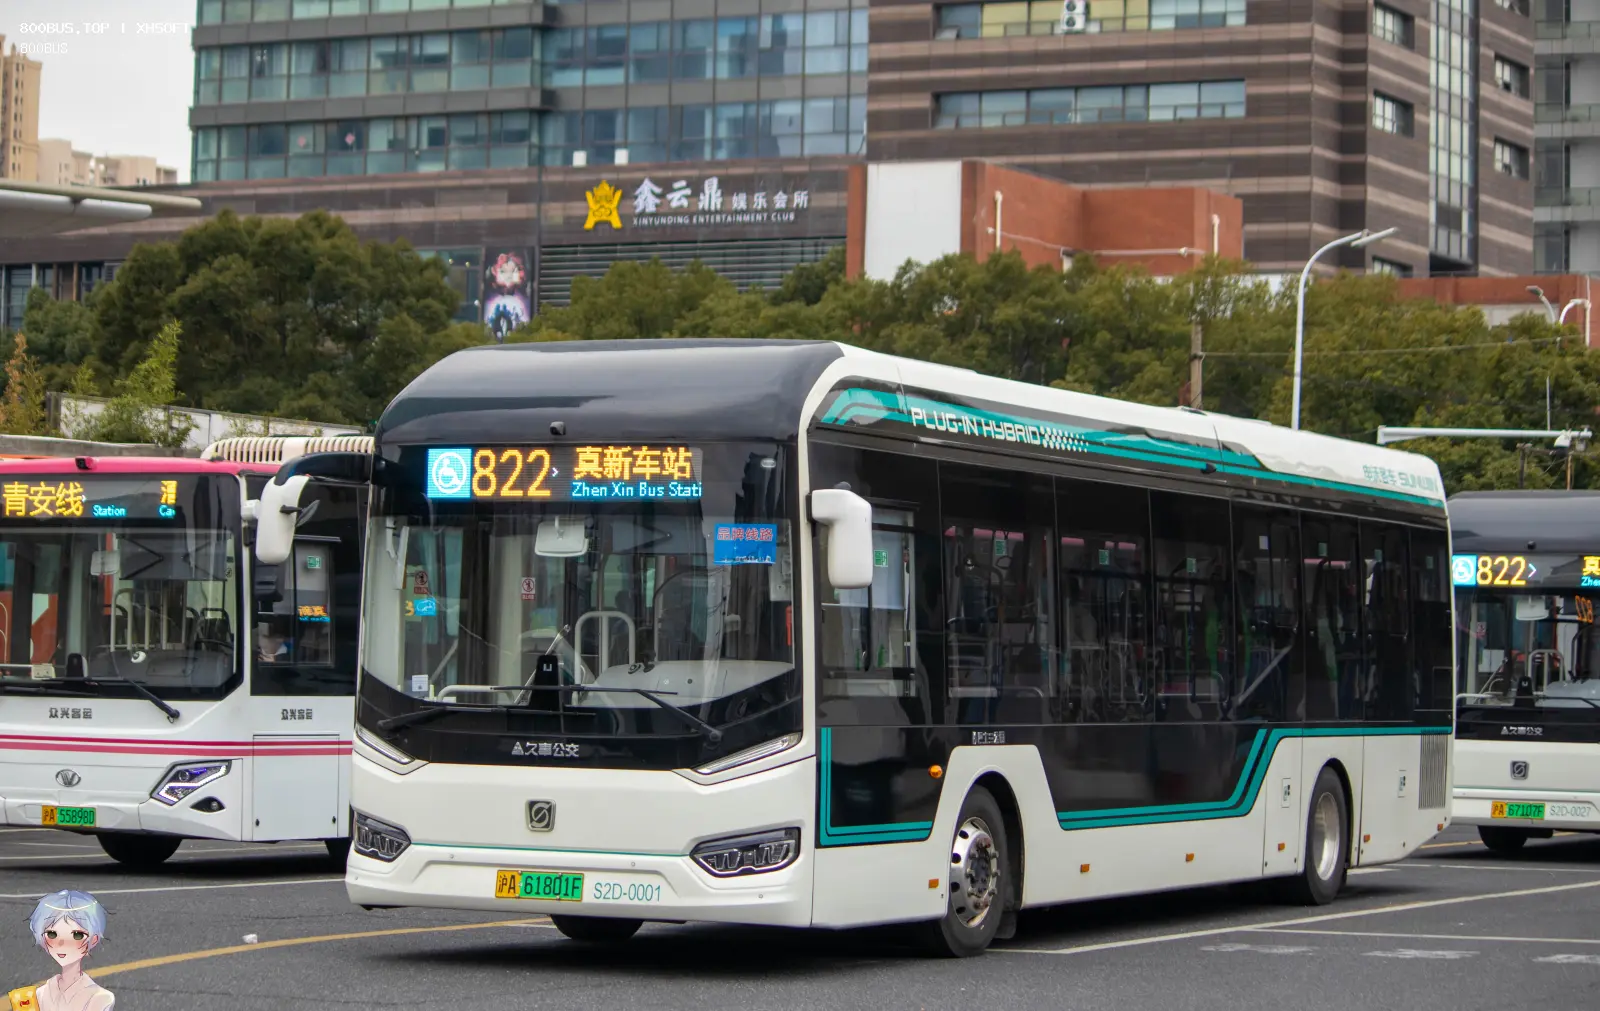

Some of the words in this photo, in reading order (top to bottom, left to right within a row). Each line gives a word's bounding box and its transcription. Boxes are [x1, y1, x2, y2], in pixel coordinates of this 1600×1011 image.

[633, 176, 724, 214] 鑫云鼎
[731, 190, 809, 211] 娱乐会所
[632, 215, 690, 226] XINYUNDING
[692, 213, 768, 224] ENTERTAINMENT
[771, 212, 795, 222] CLUB
[981, 418, 1041, 446] HYBRID
[471, 449, 551, 497] 822
[574, 446, 693, 480] 真新车站
[2, 481, 84, 517] 青安线
[572, 482, 608, 497] Zhen
[611, 482, 634, 497] Xin
[639, 482, 664, 497] Bus
[93, 505, 126, 517] Station
[717, 527, 773, 541] 品牌线路
[1477, 556, 1526, 585] 822
[48, 707, 93, 719] 众兴客运
[498, 875, 516, 894] 沪A
[524, 875, 582, 897] 61801F
[593, 883, 661, 901] S2D-0001
